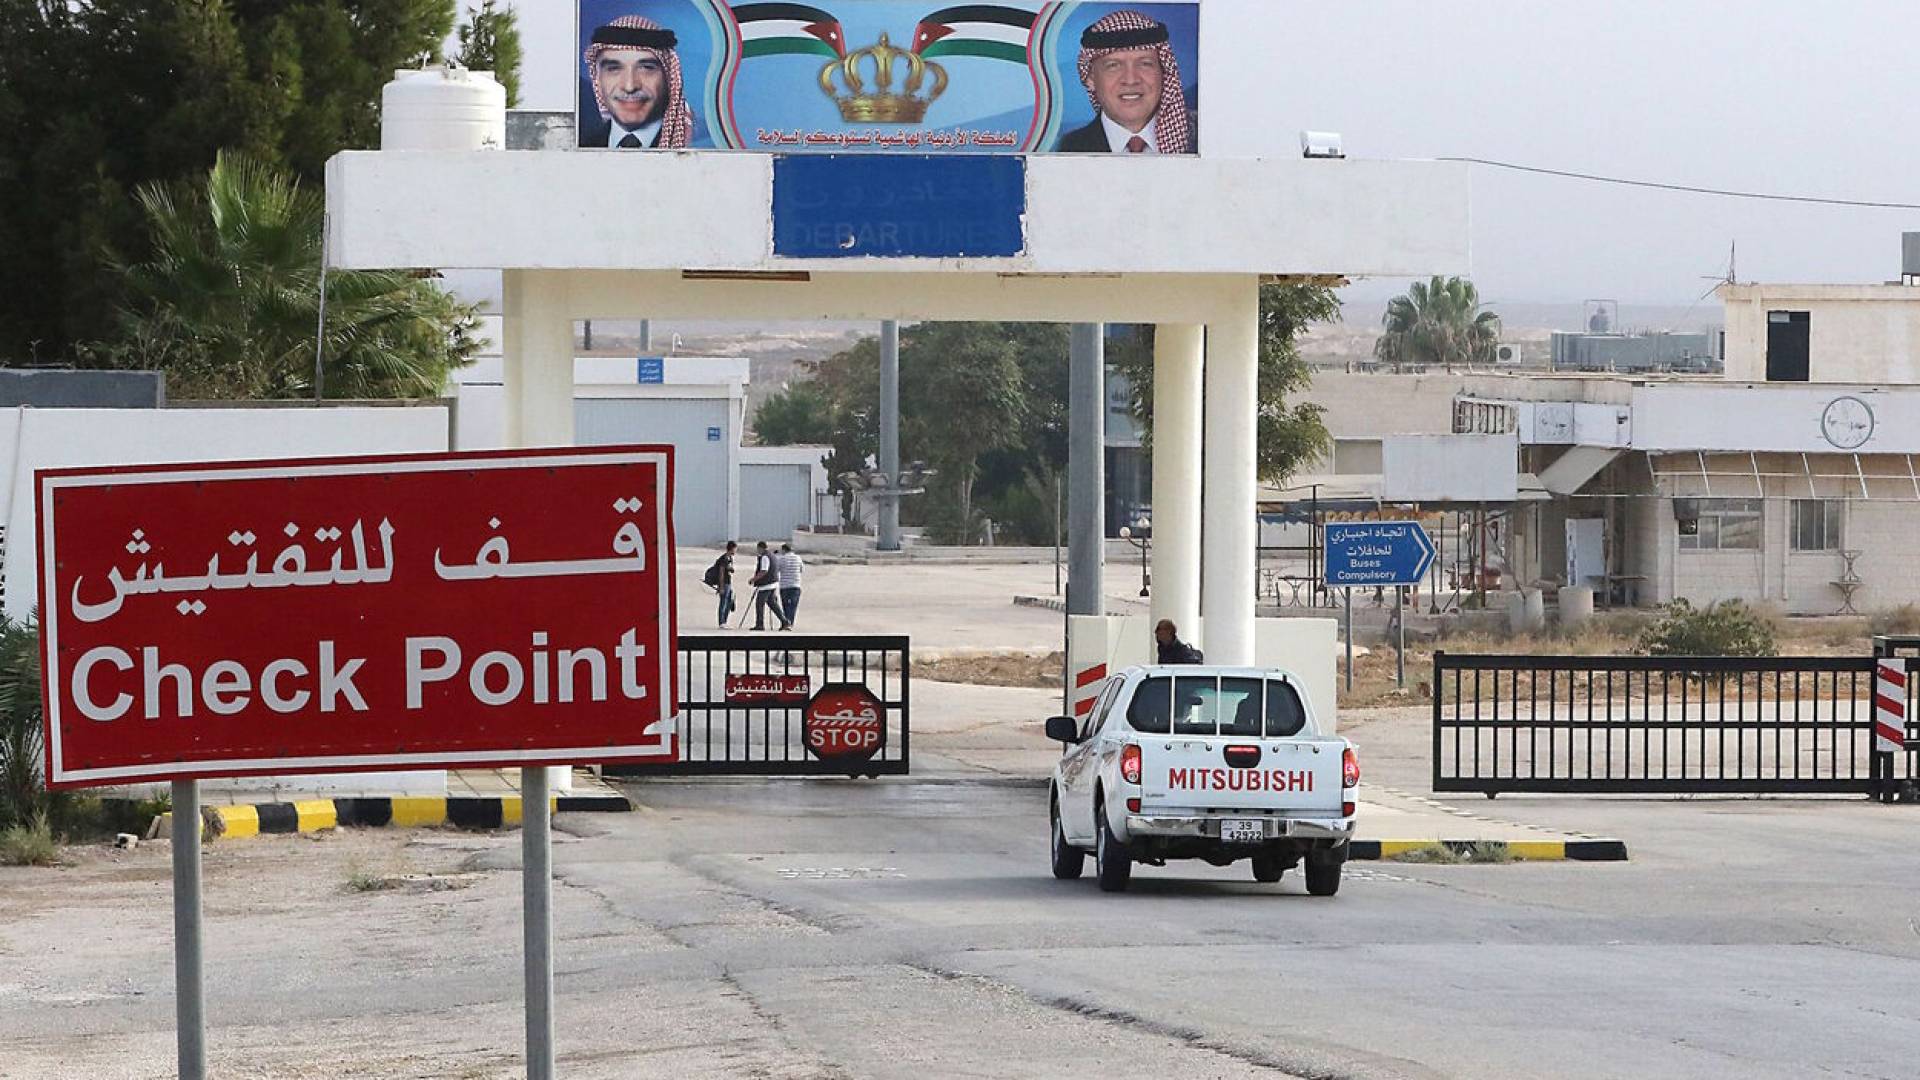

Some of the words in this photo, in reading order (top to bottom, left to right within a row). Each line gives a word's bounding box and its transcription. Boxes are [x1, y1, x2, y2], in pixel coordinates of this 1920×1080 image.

[757, 128, 801, 146] السلامة
[875, 128, 922, 149] الهاشمية
[926, 127, 969, 149] الأردنية
[972, 129, 1017, 146] المملكة
[434, 496, 647, 581] قف
[1375, 526, 1406, 540] اتجاه
[1346, 543, 1392, 557] للحافلات
[70, 515, 396, 623] للتفتيش
[1350, 559, 1381, 568] Buses
[1337, 570, 1397, 580] Compulsory
[71, 638, 370, 722] Check
[404, 626, 649, 711] Point
[726, 680, 783, 697] للتفتيش
[785, 680, 809, 694] قف
[813, 701, 878, 723] قف
[810, 728, 878, 748] STOP
[1168, 767, 1313, 792] MITSUBISHI
[1239, 821, 1253, 830] 39
[1229, 830, 1262, 841] 42922
